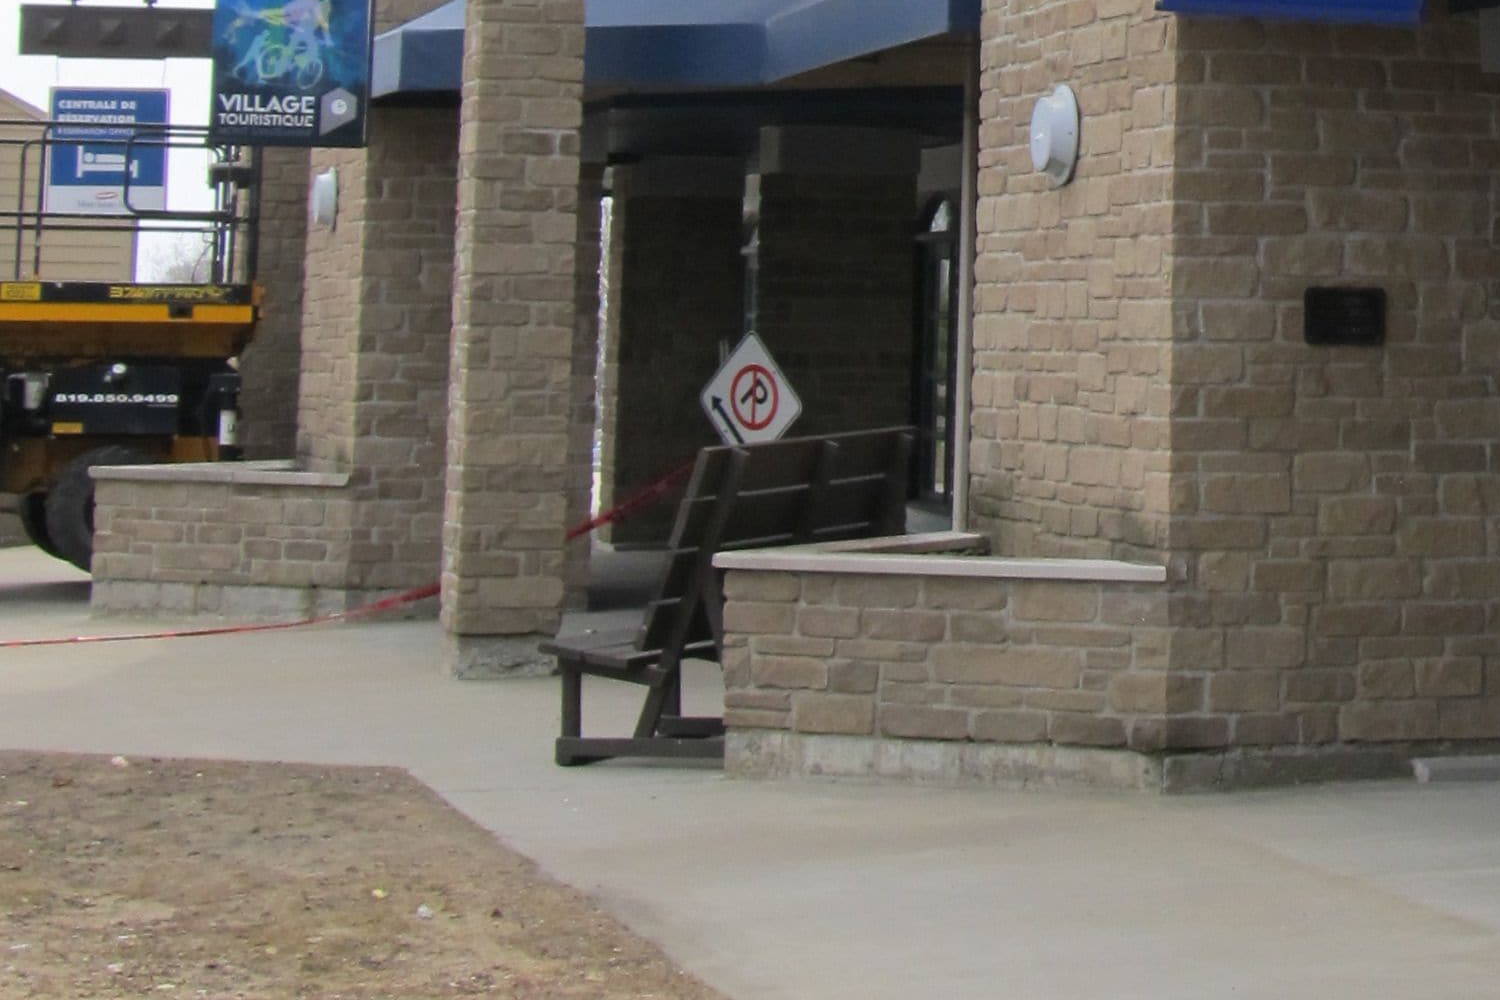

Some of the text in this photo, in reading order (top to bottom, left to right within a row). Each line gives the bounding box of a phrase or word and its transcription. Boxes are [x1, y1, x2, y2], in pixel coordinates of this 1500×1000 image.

[58, 99, 136, 110] CENTRALE DE
[218, 93, 316, 114] VILLAGE
[218, 113, 314, 127] TOURISTIQUE
[55, 393, 179, 403] 819.850.9499
